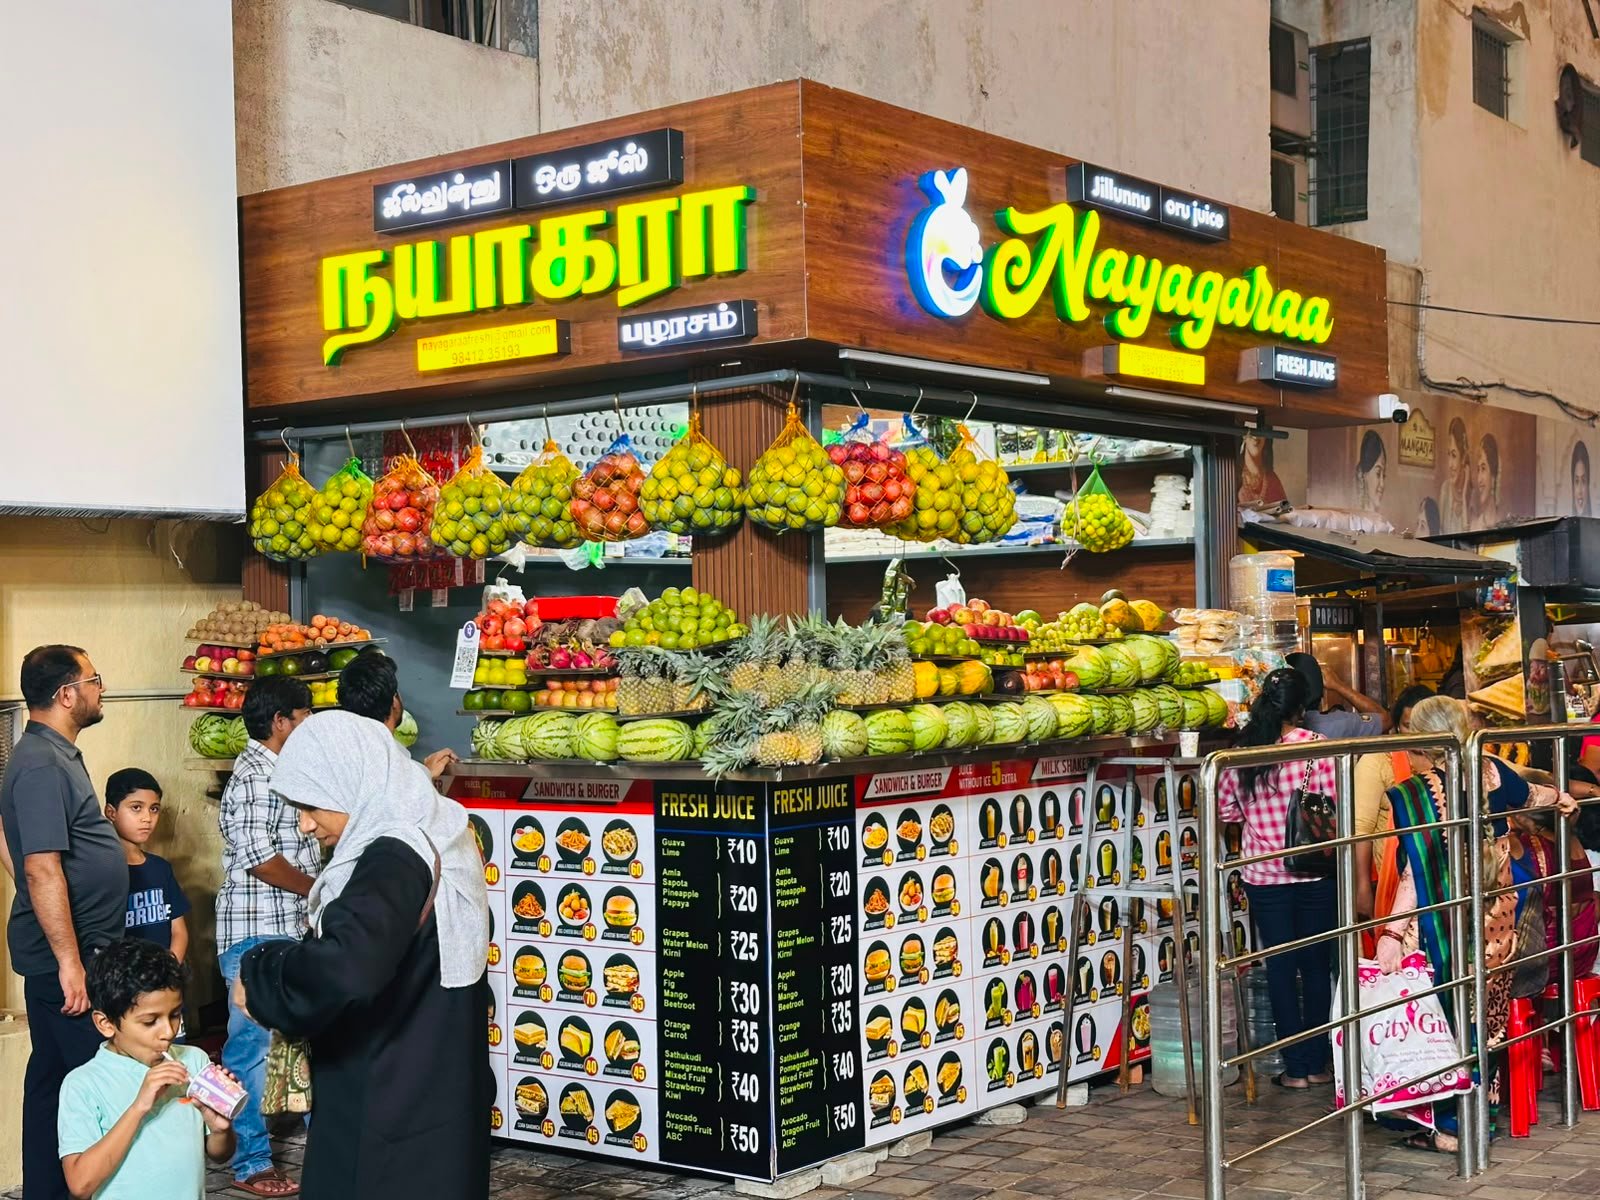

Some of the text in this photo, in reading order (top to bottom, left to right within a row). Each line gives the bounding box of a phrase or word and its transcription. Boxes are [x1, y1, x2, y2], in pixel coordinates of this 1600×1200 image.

[535, 165, 581, 195] ஒரு
[586, 142, 648, 185] ஜூஸ்
[1091, 174, 1225, 229] Jillunnu oru juice
[321, 184, 756, 366] நயாகரா
[986, 202, 1334, 349] Nayagaraa
[622, 302, 738, 346] பழரசம்
[451, 344, 521, 365] 98412 35193
[1276, 354, 1335, 381] FRESH JUICE
[1041, 760, 1060, 776] MILK
[958, 761, 1017, 790] WITHOUT ICE 5 EXTRA
[534, 782, 620, 799] SANDWICH & BURGER
[874, 772, 943, 795] SANDWICH & BURGER
[774, 784, 848, 814] FRESH JUICE
[662, 793, 755, 820] FRESH JUICE
[662, 838, 685, 847] Guava
[775, 837, 794, 845] Guava
[828, 826, 849, 850] ₹10
[662, 848, 680, 856] Lime
[728, 838, 757, 864] ₹10
[540, 858, 550, 871] 40
[583, 859, 595, 873] 60
[630, 863, 642, 876] 60
[485, 866, 498, 882] 40
[663, 868, 681, 877] Amla
[776, 868, 791, 876] Amla
[663, 878, 688, 888] Sapota
[776, 877, 797, 887] Sapota
[830, 871, 850, 898] ₹20
[663, 888, 699, 898] Pineapple
[776, 886, 806, 896] Pineapple
[1028, 886, 1036, 901] 50
[663, 899, 690, 908] Papaya
[730, 885, 757, 912] ₹20
[777, 898, 799, 907] Papaya
[999, 891, 1008, 906] 50
[540, 922, 551, 935] 60
[584, 926, 595, 939] 60
[663, 929, 689, 938] Grapes
[778, 928, 799, 938] Grapes
[831, 915, 851, 944] ₹25
[632, 929, 643, 943] 50
[778, 936, 814, 948] Water Melon
[663, 938, 708, 949] Water Melon
[731, 930, 758, 961] ₹25
[778, 950, 792, 959] Kirni
[1030, 944, 1038, 958] 50
[663, 969, 685, 978] Apple
[778, 970, 795, 980] Apple
[952, 960, 962, 976] 35
[831, 963, 852, 996] ₹30
[919, 968, 928, 983] 70
[664, 979, 675, 989] Fig
[778, 982, 788, 991] Fig
[541, 987, 551, 1000] 60
[586, 991, 596, 1005] 70
[664, 990, 688, 999] Mango
[731, 981, 759, 1015] ₹30
[778, 991, 798, 1001] Mango
[632, 996, 644, 1011] 35
[664, 1000, 695, 1010] Beetroot
[778, 1000, 804, 1012] Beetroot
[1032, 1003, 1040, 1018] 50
[832, 1000, 851, 1034] ₹35
[664, 1020, 690, 1030] Orange
[779, 1021, 800, 1032] Orange
[954, 1024, 964, 1039] 45
[1368, 1018, 1410, 1046] City
[488, 1027, 501, 1043] 50
[664, 1030, 687, 1040] Carrot
[732, 1019, 759, 1054] ₹35
[779, 1032, 797, 1043] Carrot
[541, 1054, 552, 1067] 40
[665, 1050, 701, 1062] Sathukudi
[780, 1049, 809, 1064] Sathukudi
[586, 1060, 597, 1073] 40
[665, 1060, 712, 1074] Pomegranate
[780, 1057, 818, 1074] Pomegranate
[833, 1050, 854, 1081] ₹40
[1034, 1063, 1042, 1078] 50
[633, 1066, 645, 1080] 45
[665, 1071, 706, 1083] Mixed Fruit
[780, 1069, 813, 1085] Mixed Fruit
[665, 1080, 705, 1095] Strawberry
[732, 1071, 759, 1103] ₹40
[780, 1081, 812, 1095] Strawberry
[956, 1086, 966, 1102] 50
[665, 1091, 681, 1100] Kiwi
[781, 1096, 793, 1105] Kiwi
[924, 1096, 934, 1112] 45
[666, 1111, 697, 1122] Avocado
[781, 1113, 808, 1126] Avocado
[834, 1102, 855, 1132] ₹50
[891, 1107, 900, 1122] 45
[543, 1122, 554, 1135] 45
[587, 1128, 598, 1142] 45
[666, 1121, 712, 1135] Dragon Fruit
[781, 1119, 820, 1137] Dragon Fruit
[634, 1136, 646, 1150] 50
[666, 1132, 682, 1141] ABC
[730, 1123, 759, 1153] ₹50
[783, 1139, 796, 1149] ABC
